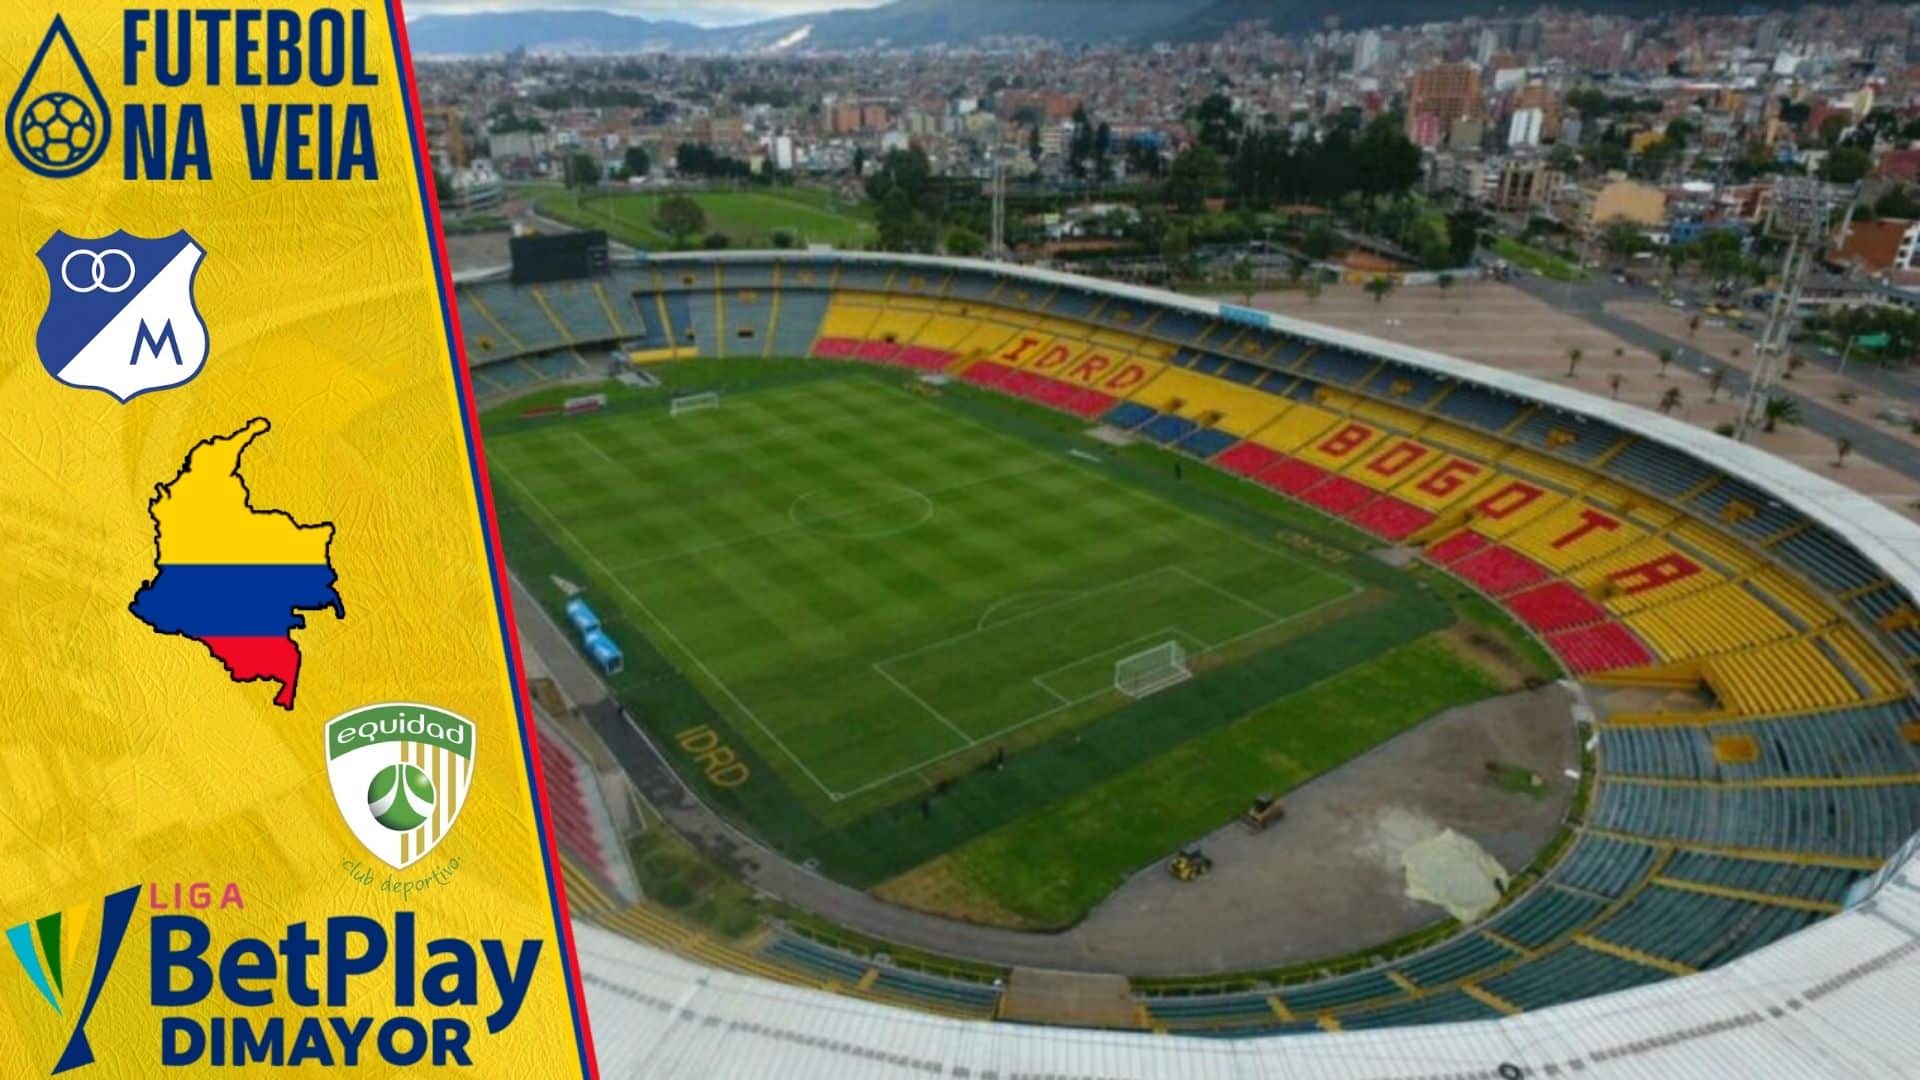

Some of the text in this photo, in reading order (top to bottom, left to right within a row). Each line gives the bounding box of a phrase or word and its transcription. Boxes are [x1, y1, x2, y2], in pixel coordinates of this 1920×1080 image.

[1002, 337, 1146, 390] IDRD
[1316, 422, 1704, 596] BOGOTA
[674, 723, 750, 788] IDRD
